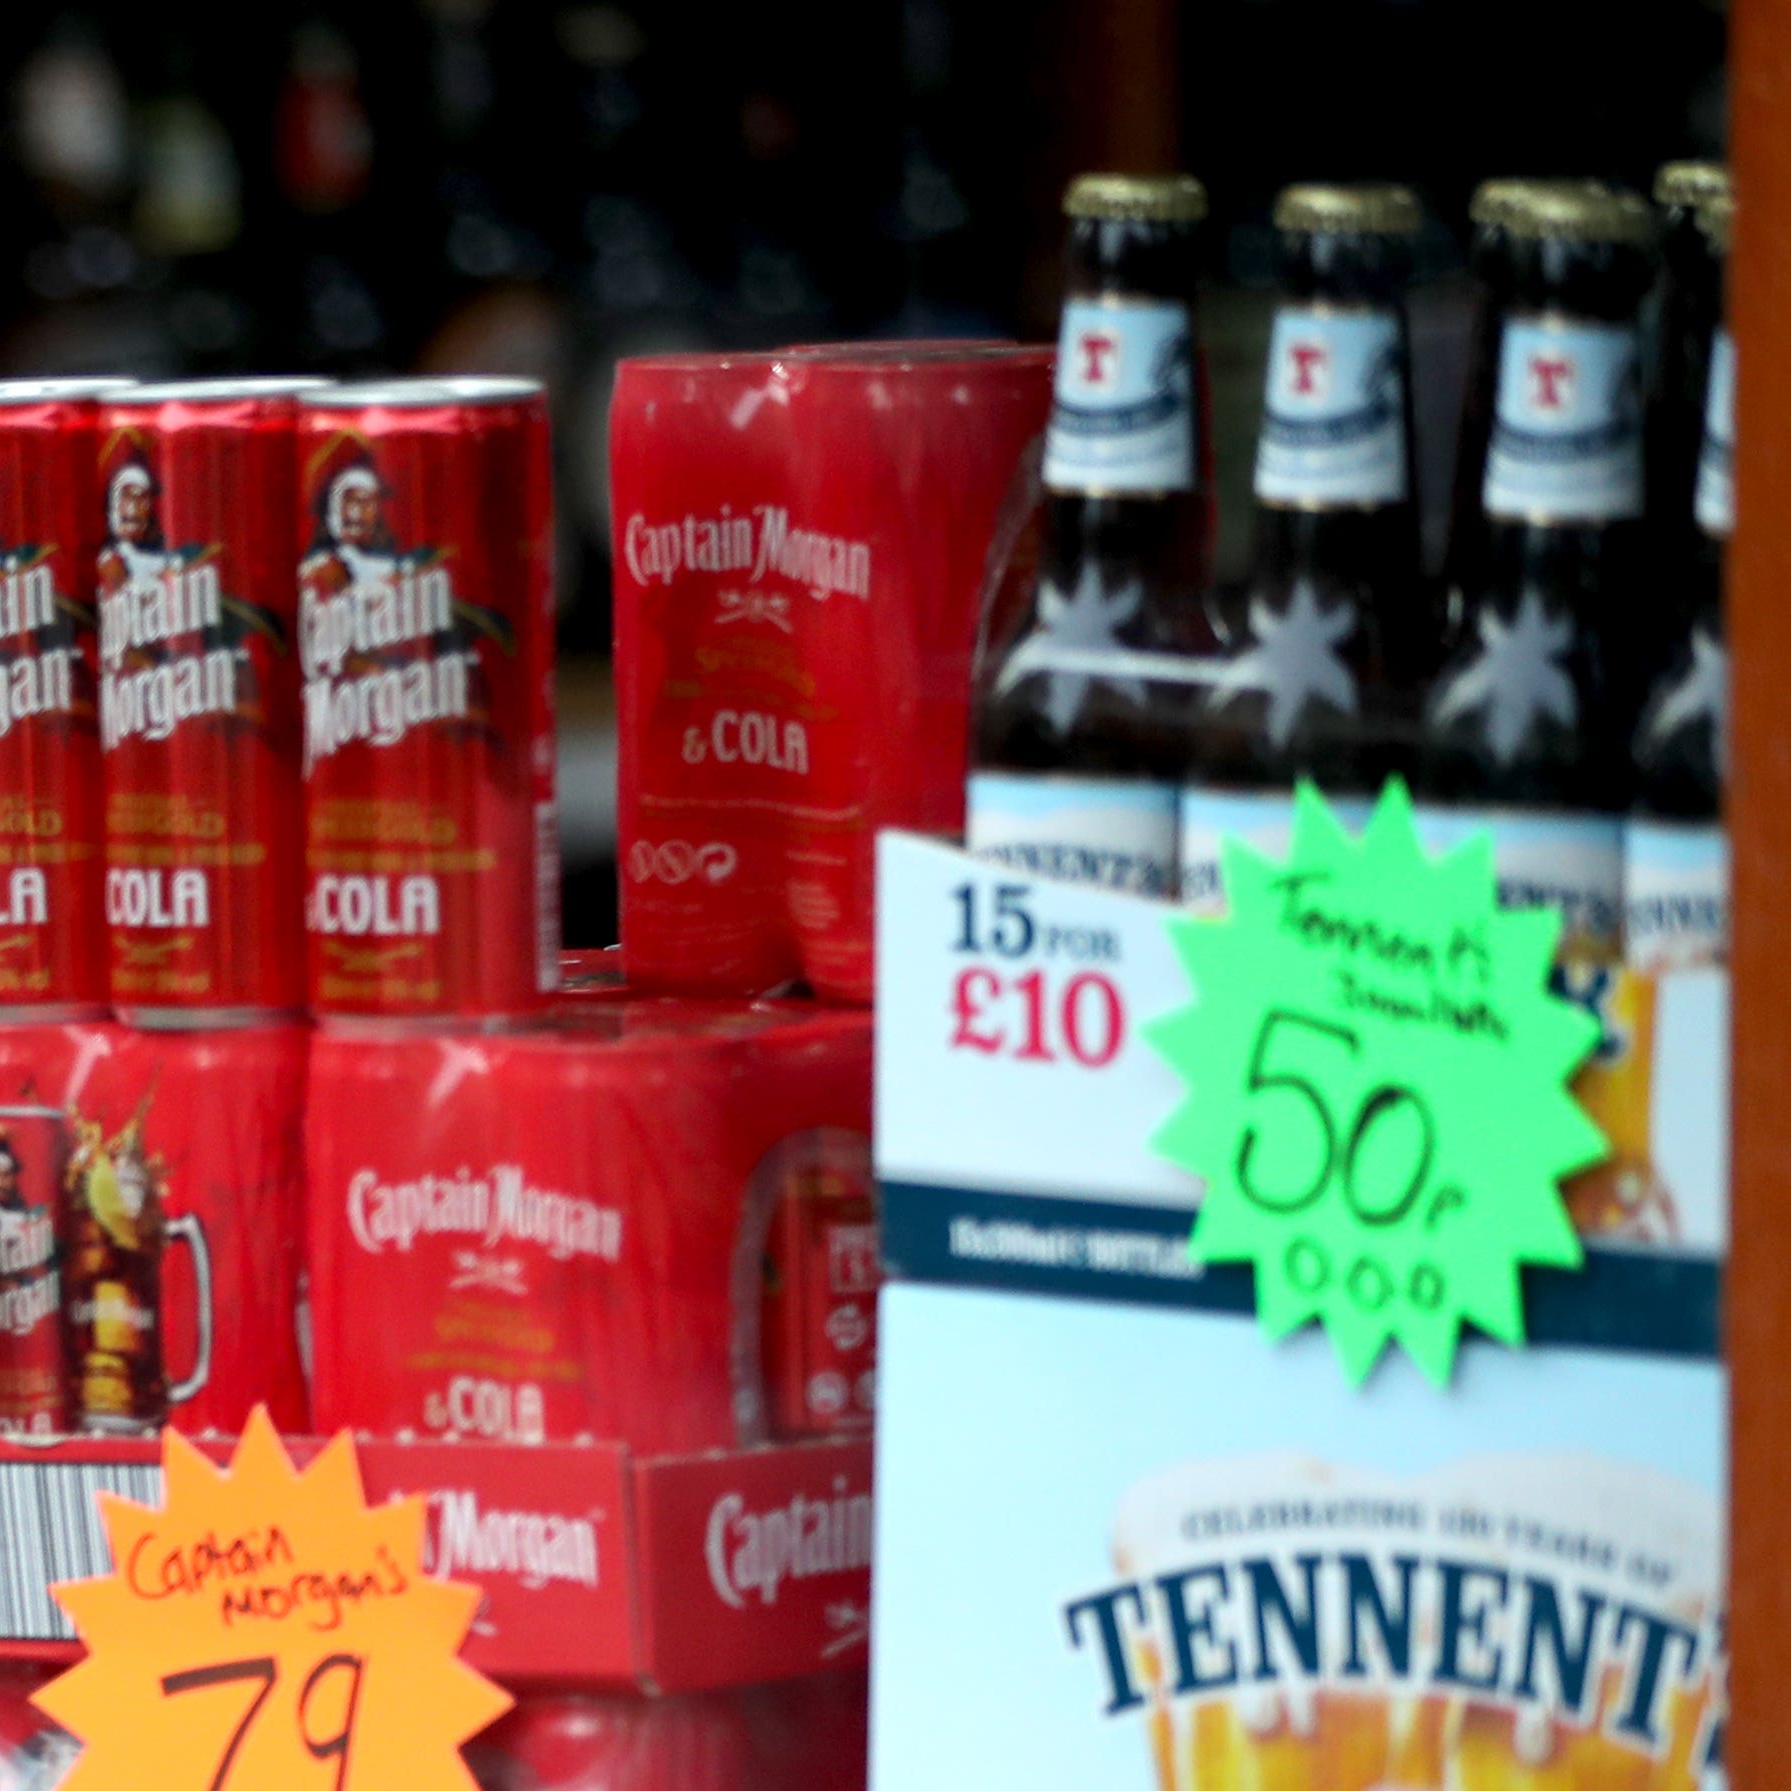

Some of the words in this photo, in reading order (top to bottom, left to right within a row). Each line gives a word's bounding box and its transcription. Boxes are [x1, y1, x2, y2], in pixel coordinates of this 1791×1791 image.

[1075, 332, 1114, 384] T
[1287, 343, 1328, 395] T
[1526, 354, 1576, 410] T
[625, 503, 754, 586] Captain
[749, 503, 872, 600] Morgan
[302, 648, 469, 778] Morgan
[711, 710, 809, 774] COLA
[105, 868, 210, 928] COLA
[315, 873, 440, 935] COLA
[948, 881, 1037, 957] 15
[947, 967, 1128, 1071] £10
[347, 1166, 491, 1257] Captain
[486, 1165, 625, 1263] Morgan
[448, 1375, 545, 1443] COLA
